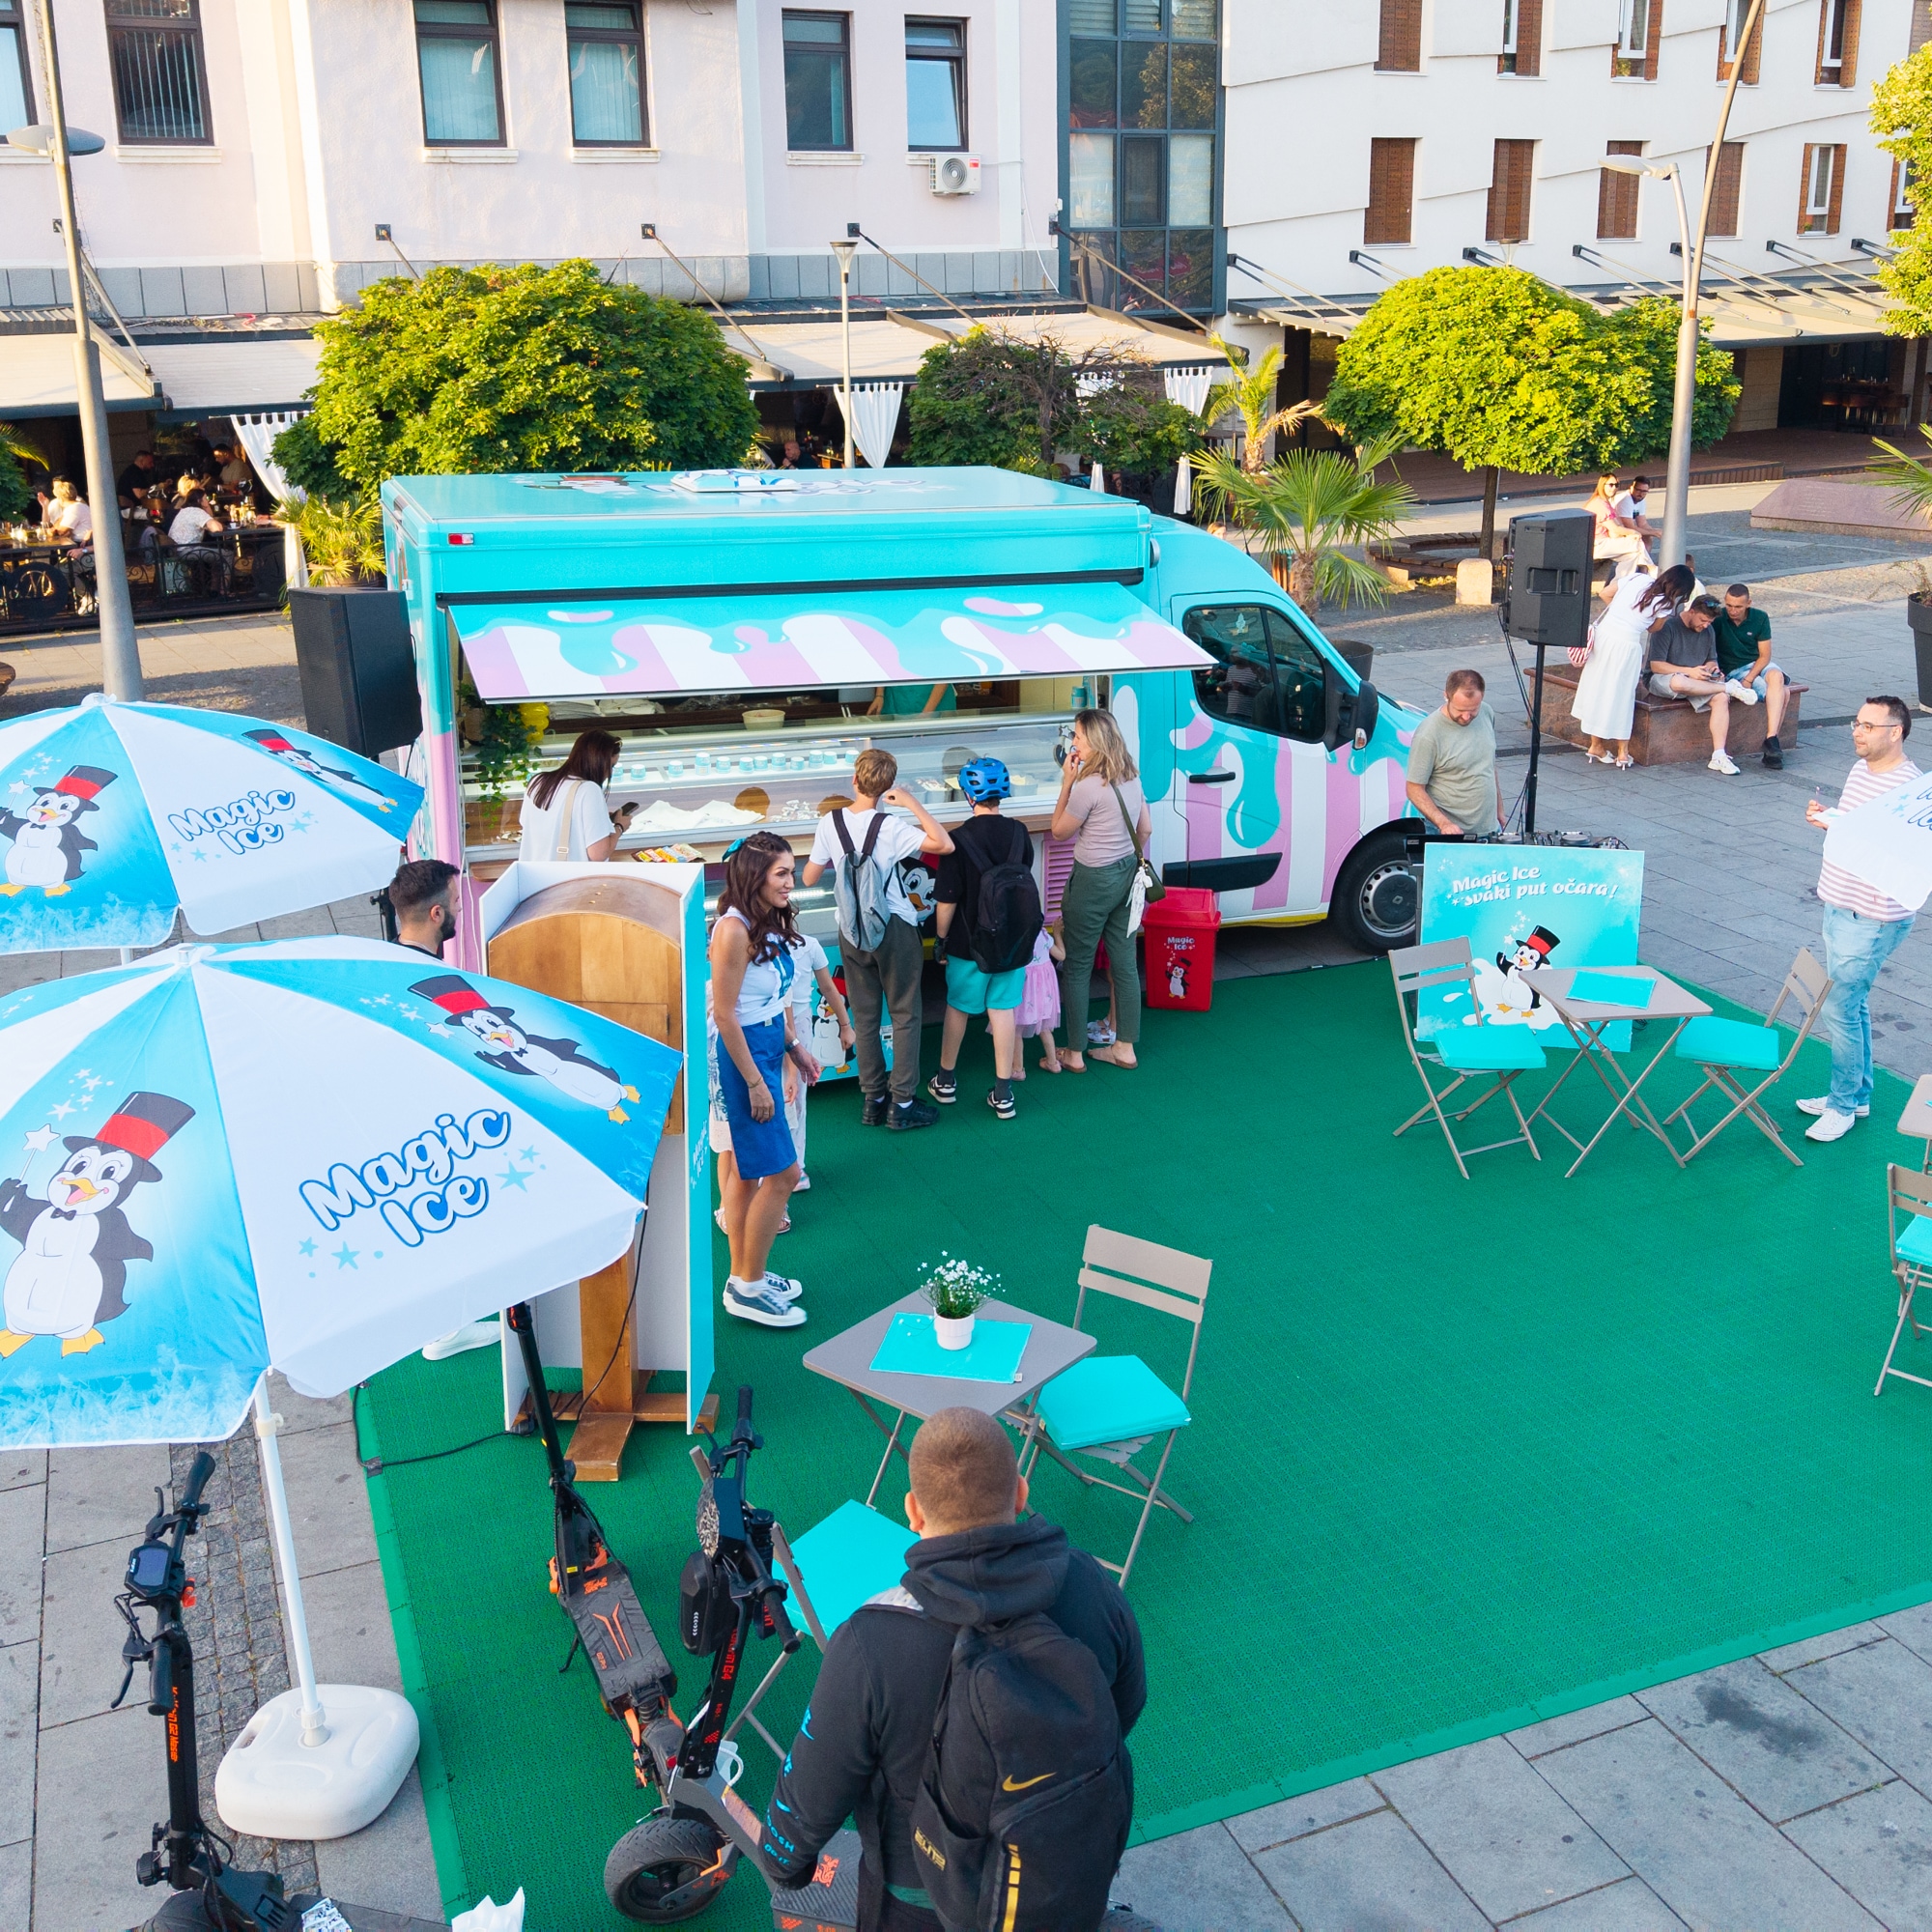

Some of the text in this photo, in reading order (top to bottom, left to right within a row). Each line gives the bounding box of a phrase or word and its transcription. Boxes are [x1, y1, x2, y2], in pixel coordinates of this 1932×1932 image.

[167, 789, 296, 841] Magic
[217, 822, 284, 855] Ice
[1452, 867, 1542, 894] Magic Ice
[1463, 883, 1511, 906] svaki
[1516, 881, 1548, 899] put
[1167, 936, 1195, 945] Magic
[298, 1108, 511, 1232] Magic
[379, 1176, 489, 1248] Ice
